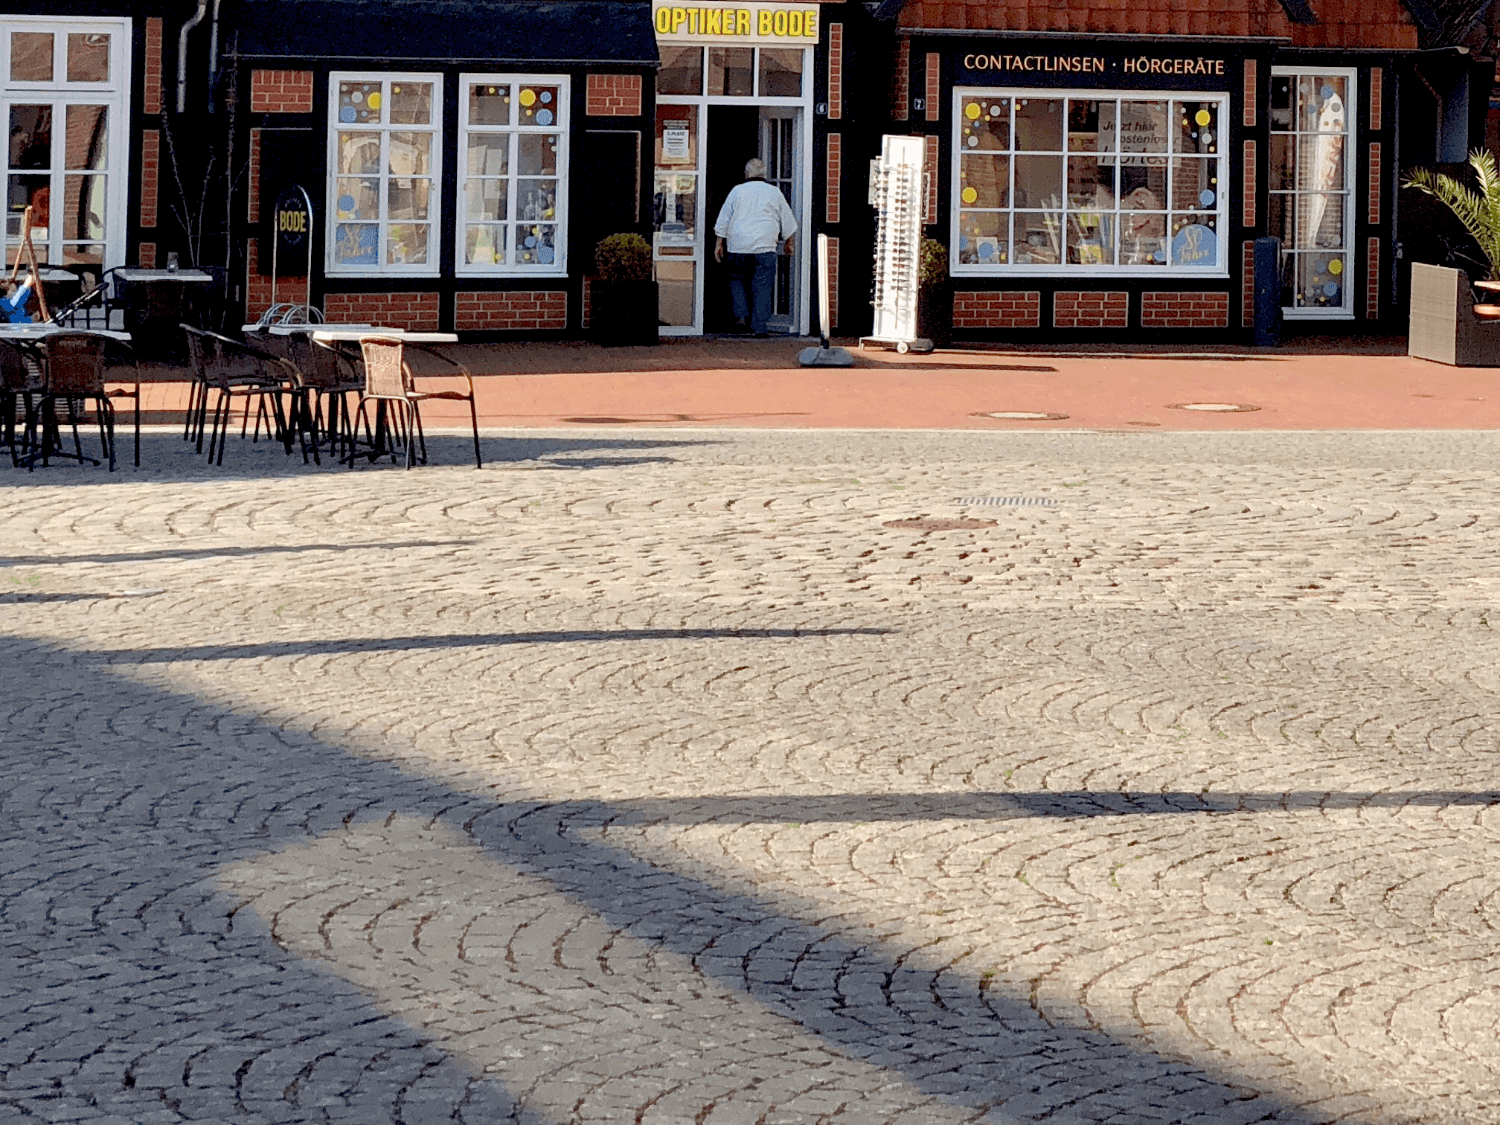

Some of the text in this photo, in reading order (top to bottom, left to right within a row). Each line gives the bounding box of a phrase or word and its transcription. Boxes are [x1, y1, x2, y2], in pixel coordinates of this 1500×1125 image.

[655, 6, 817, 38] OPTIKER BODE
[963, 54, 1225, 75] CONTACTLINSEN HÖRGERÄTE
[1103, 121, 1158, 131] Jezt hier
[1113, 133, 1181, 144] ostenlosr
[280, 210, 307, 232] BODE
